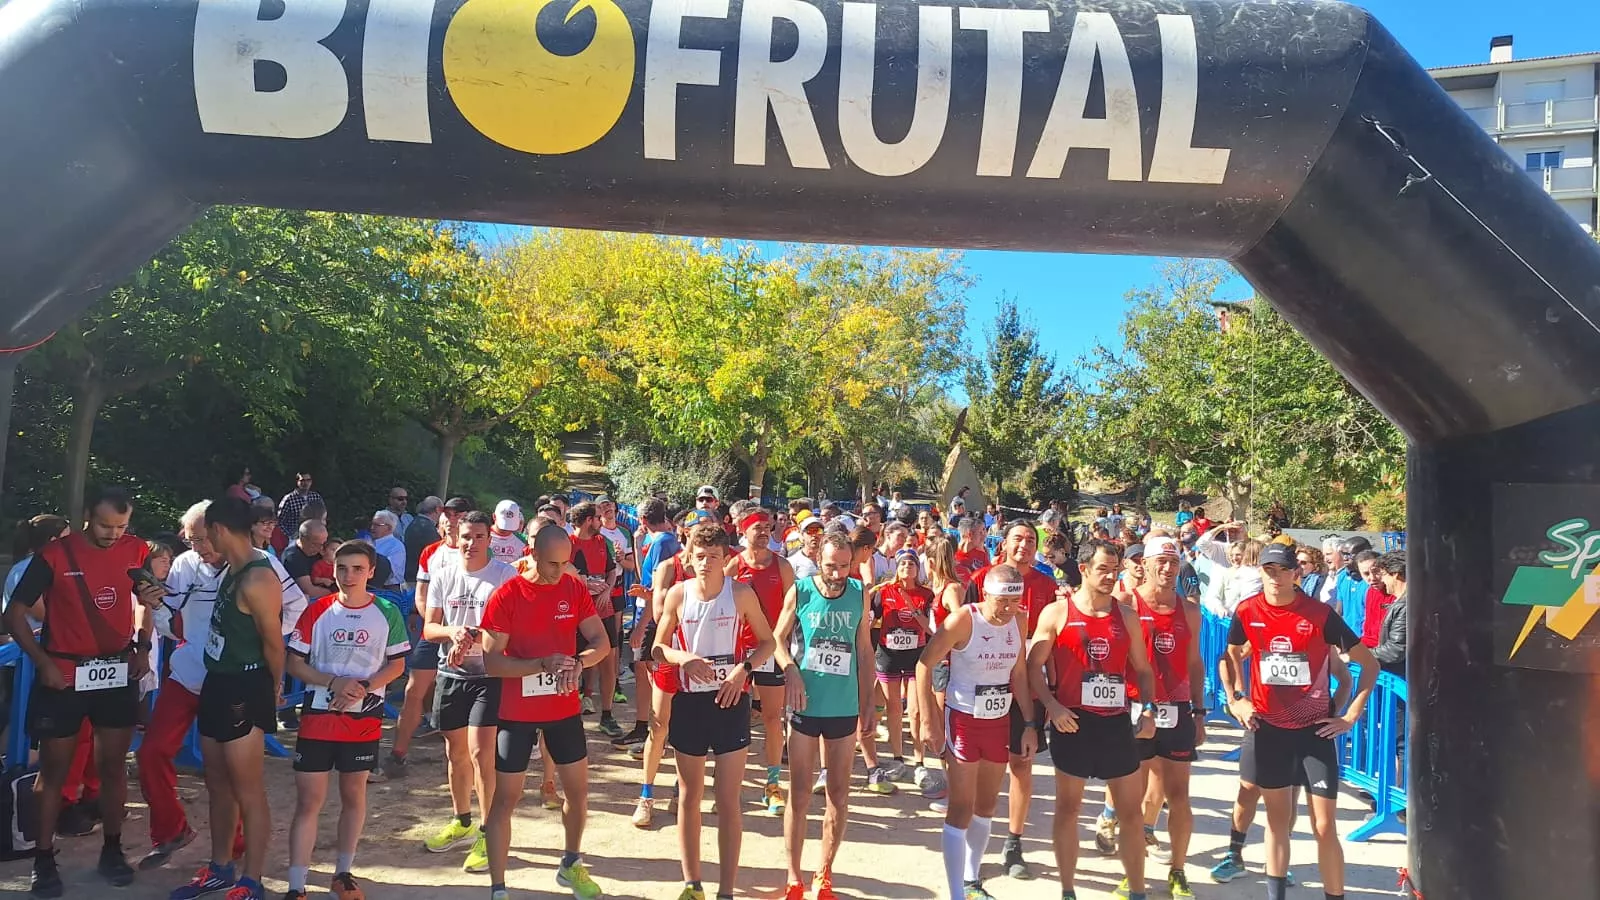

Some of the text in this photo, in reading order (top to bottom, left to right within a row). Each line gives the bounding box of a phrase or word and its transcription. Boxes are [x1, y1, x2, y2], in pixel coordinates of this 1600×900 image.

[193, 0, 1231, 184] BIOFRUTAL
[893, 635, 912, 645] 020
[817, 652, 841, 667] 162
[88, 667, 117, 682] 002
[1270, 664, 1298, 678] 040
[1093, 685, 1117, 699] 005
[985, 697, 1006, 711] 053
